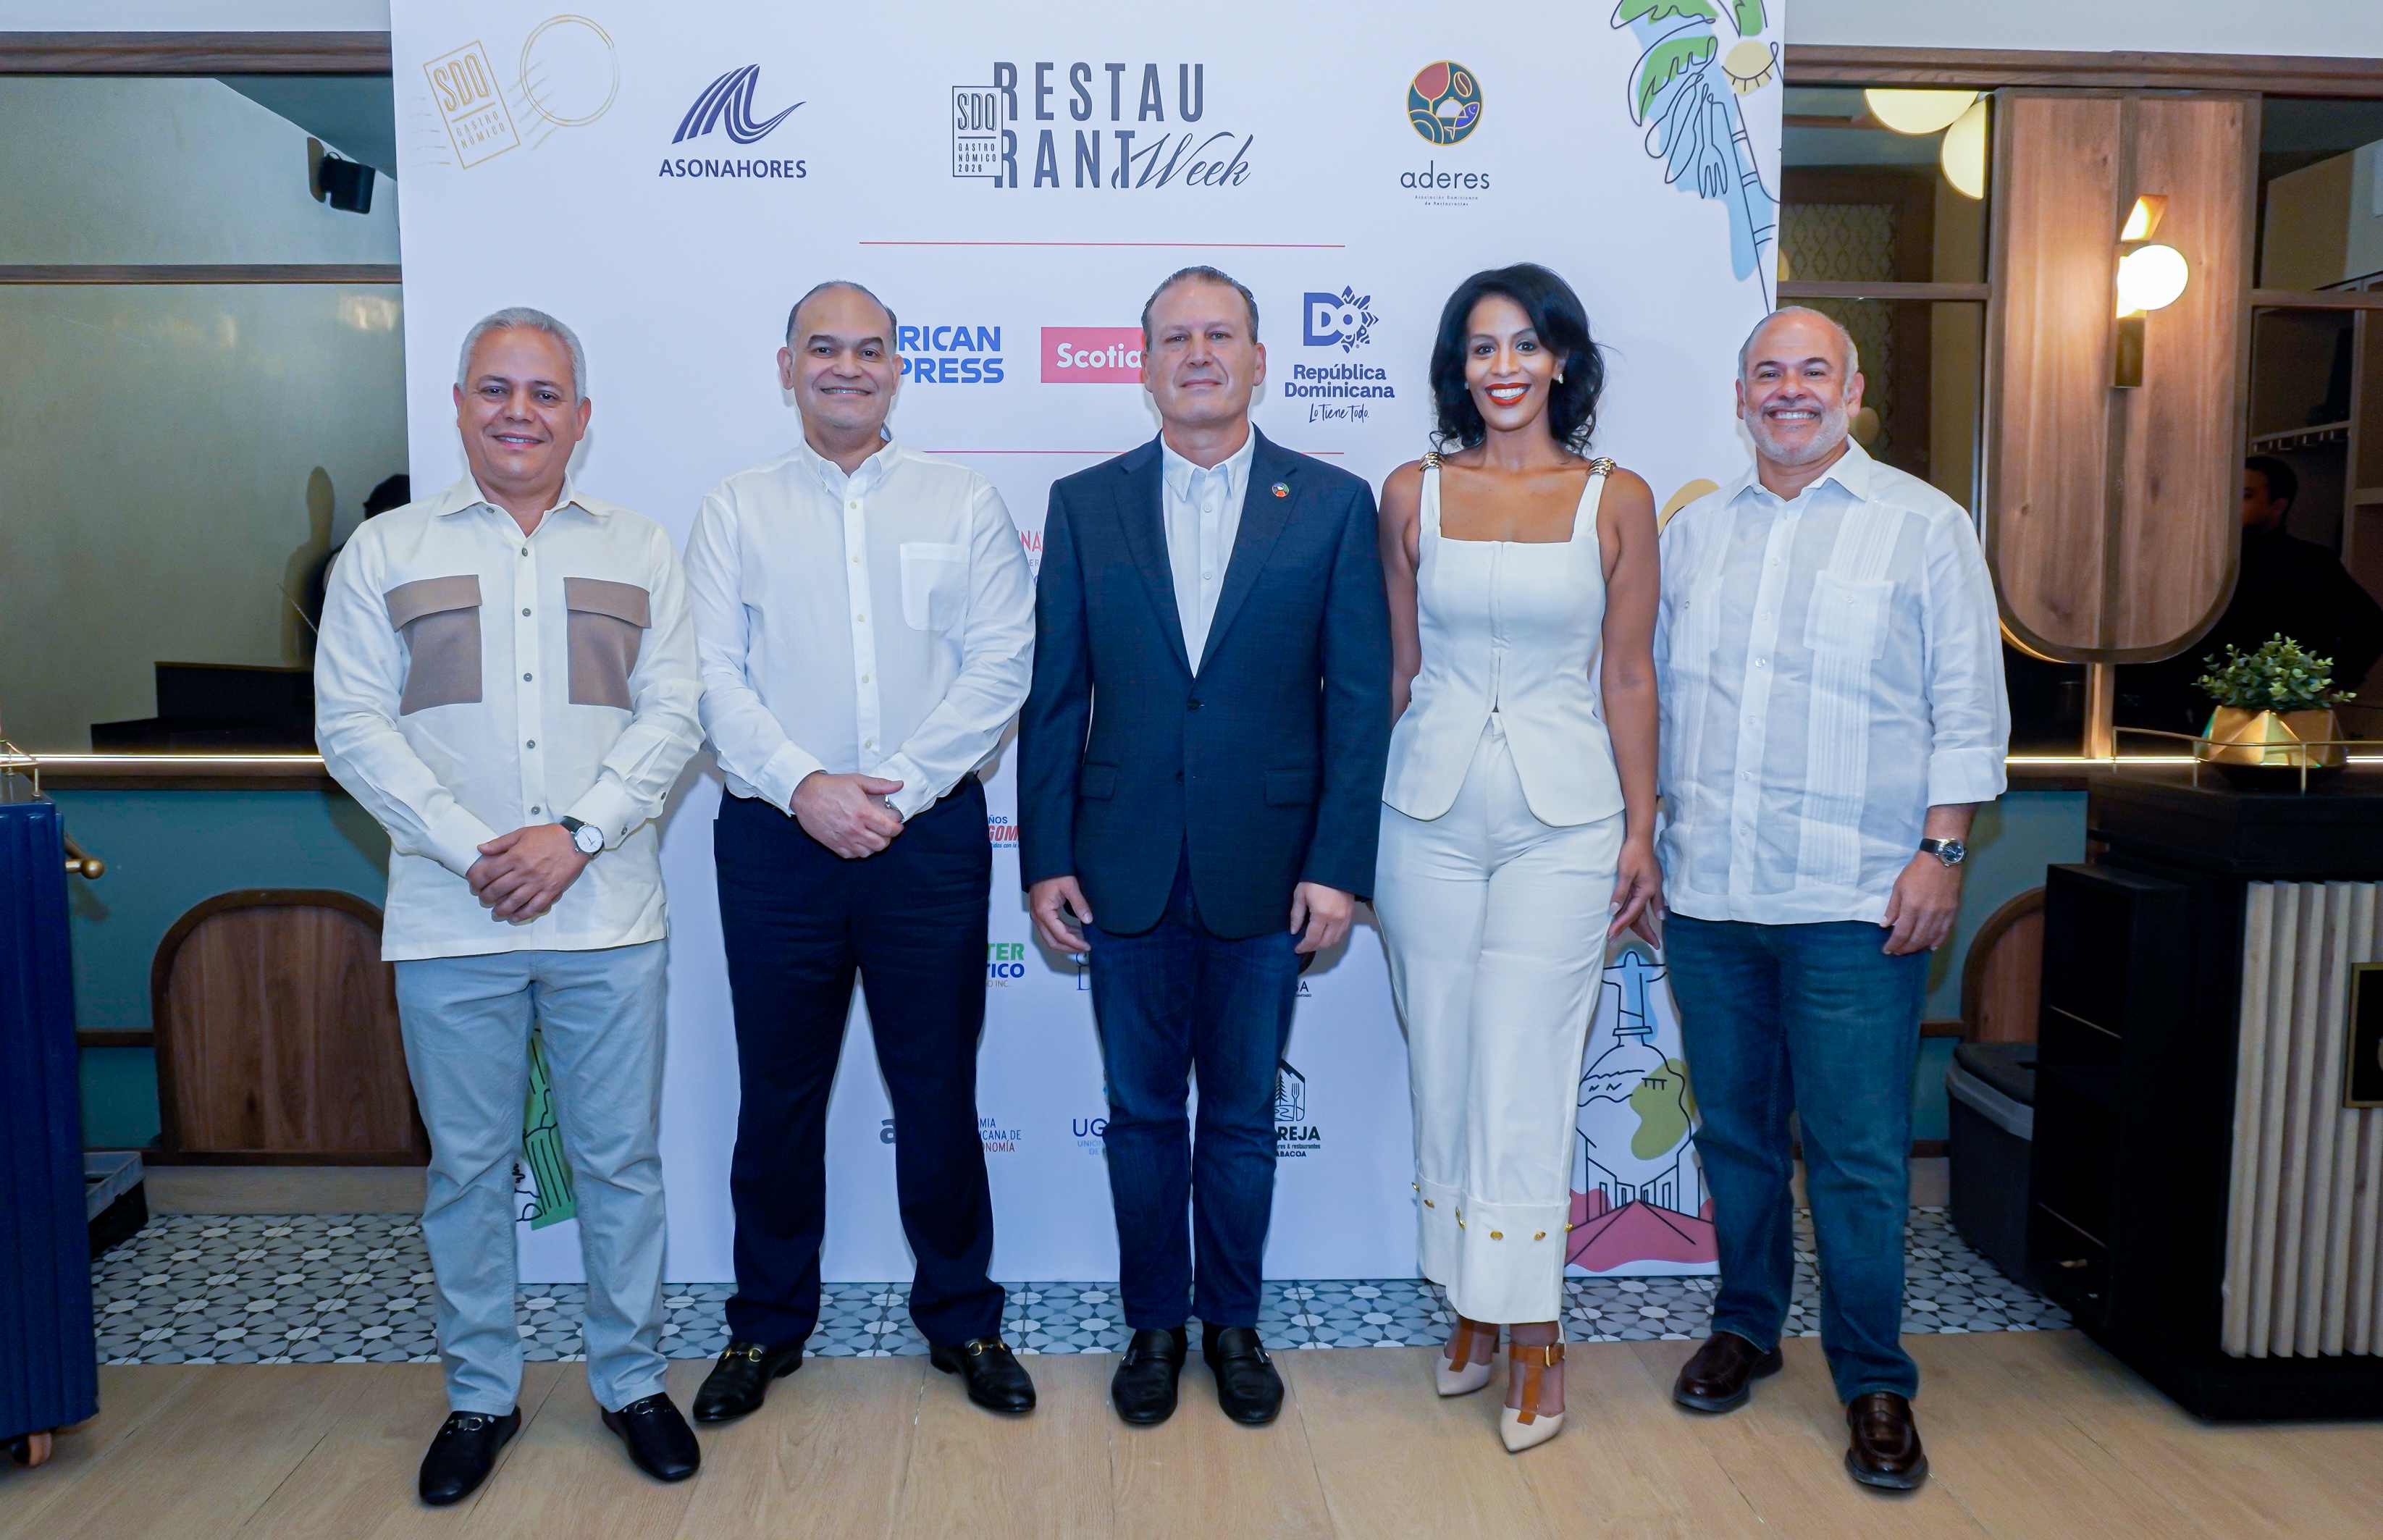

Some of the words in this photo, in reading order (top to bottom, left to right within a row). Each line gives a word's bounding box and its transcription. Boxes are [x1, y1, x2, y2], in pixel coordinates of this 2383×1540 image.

[993, 62, 1203, 122] RESTAU
[957, 93, 997, 131] SDQ
[958, 143, 995, 151] GASTRO
[958, 152, 996, 162] NÓMICO
[659, 158, 807, 178] ASONAHORES
[958, 164, 982, 172] 2026
[993, 129, 1135, 188] RANT
[1112, 131, 1254, 190] Week
[1400, 160, 1490, 190] aderes
[899, 326, 1001, 352] RICAN
[1056, 342, 1142, 369] Scotia
[1293, 363, 1387, 383] República
[1285, 381, 1395, 398] Dominicana
[1309, 403, 1319, 423] Lo
[1319, 403, 1350, 421] Tiene
[988, 815, 1008, 824] ÑOS
[987, 963, 1025, 978] ICO
[1010, 1129, 1022, 1140] DE
